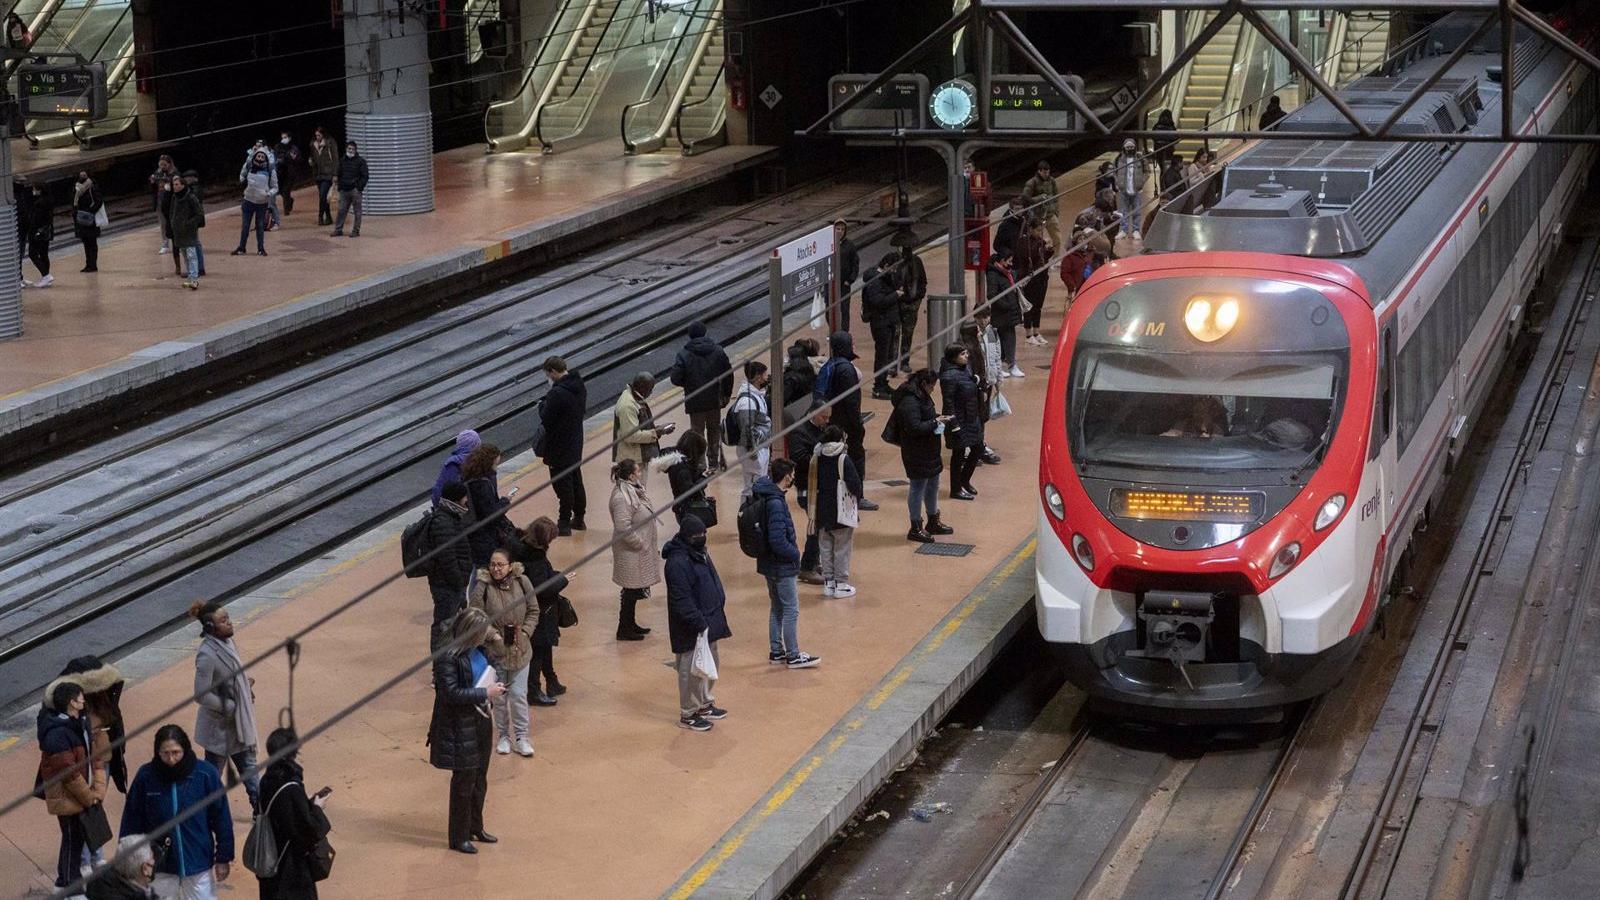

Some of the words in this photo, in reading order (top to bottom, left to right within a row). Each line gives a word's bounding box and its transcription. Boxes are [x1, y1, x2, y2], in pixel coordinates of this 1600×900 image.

[61, 73, 67, 83] 5
[1031, 86, 1038, 96] 3
[765, 91, 777, 102] 30
[1118, 93, 1129, 105] 30
